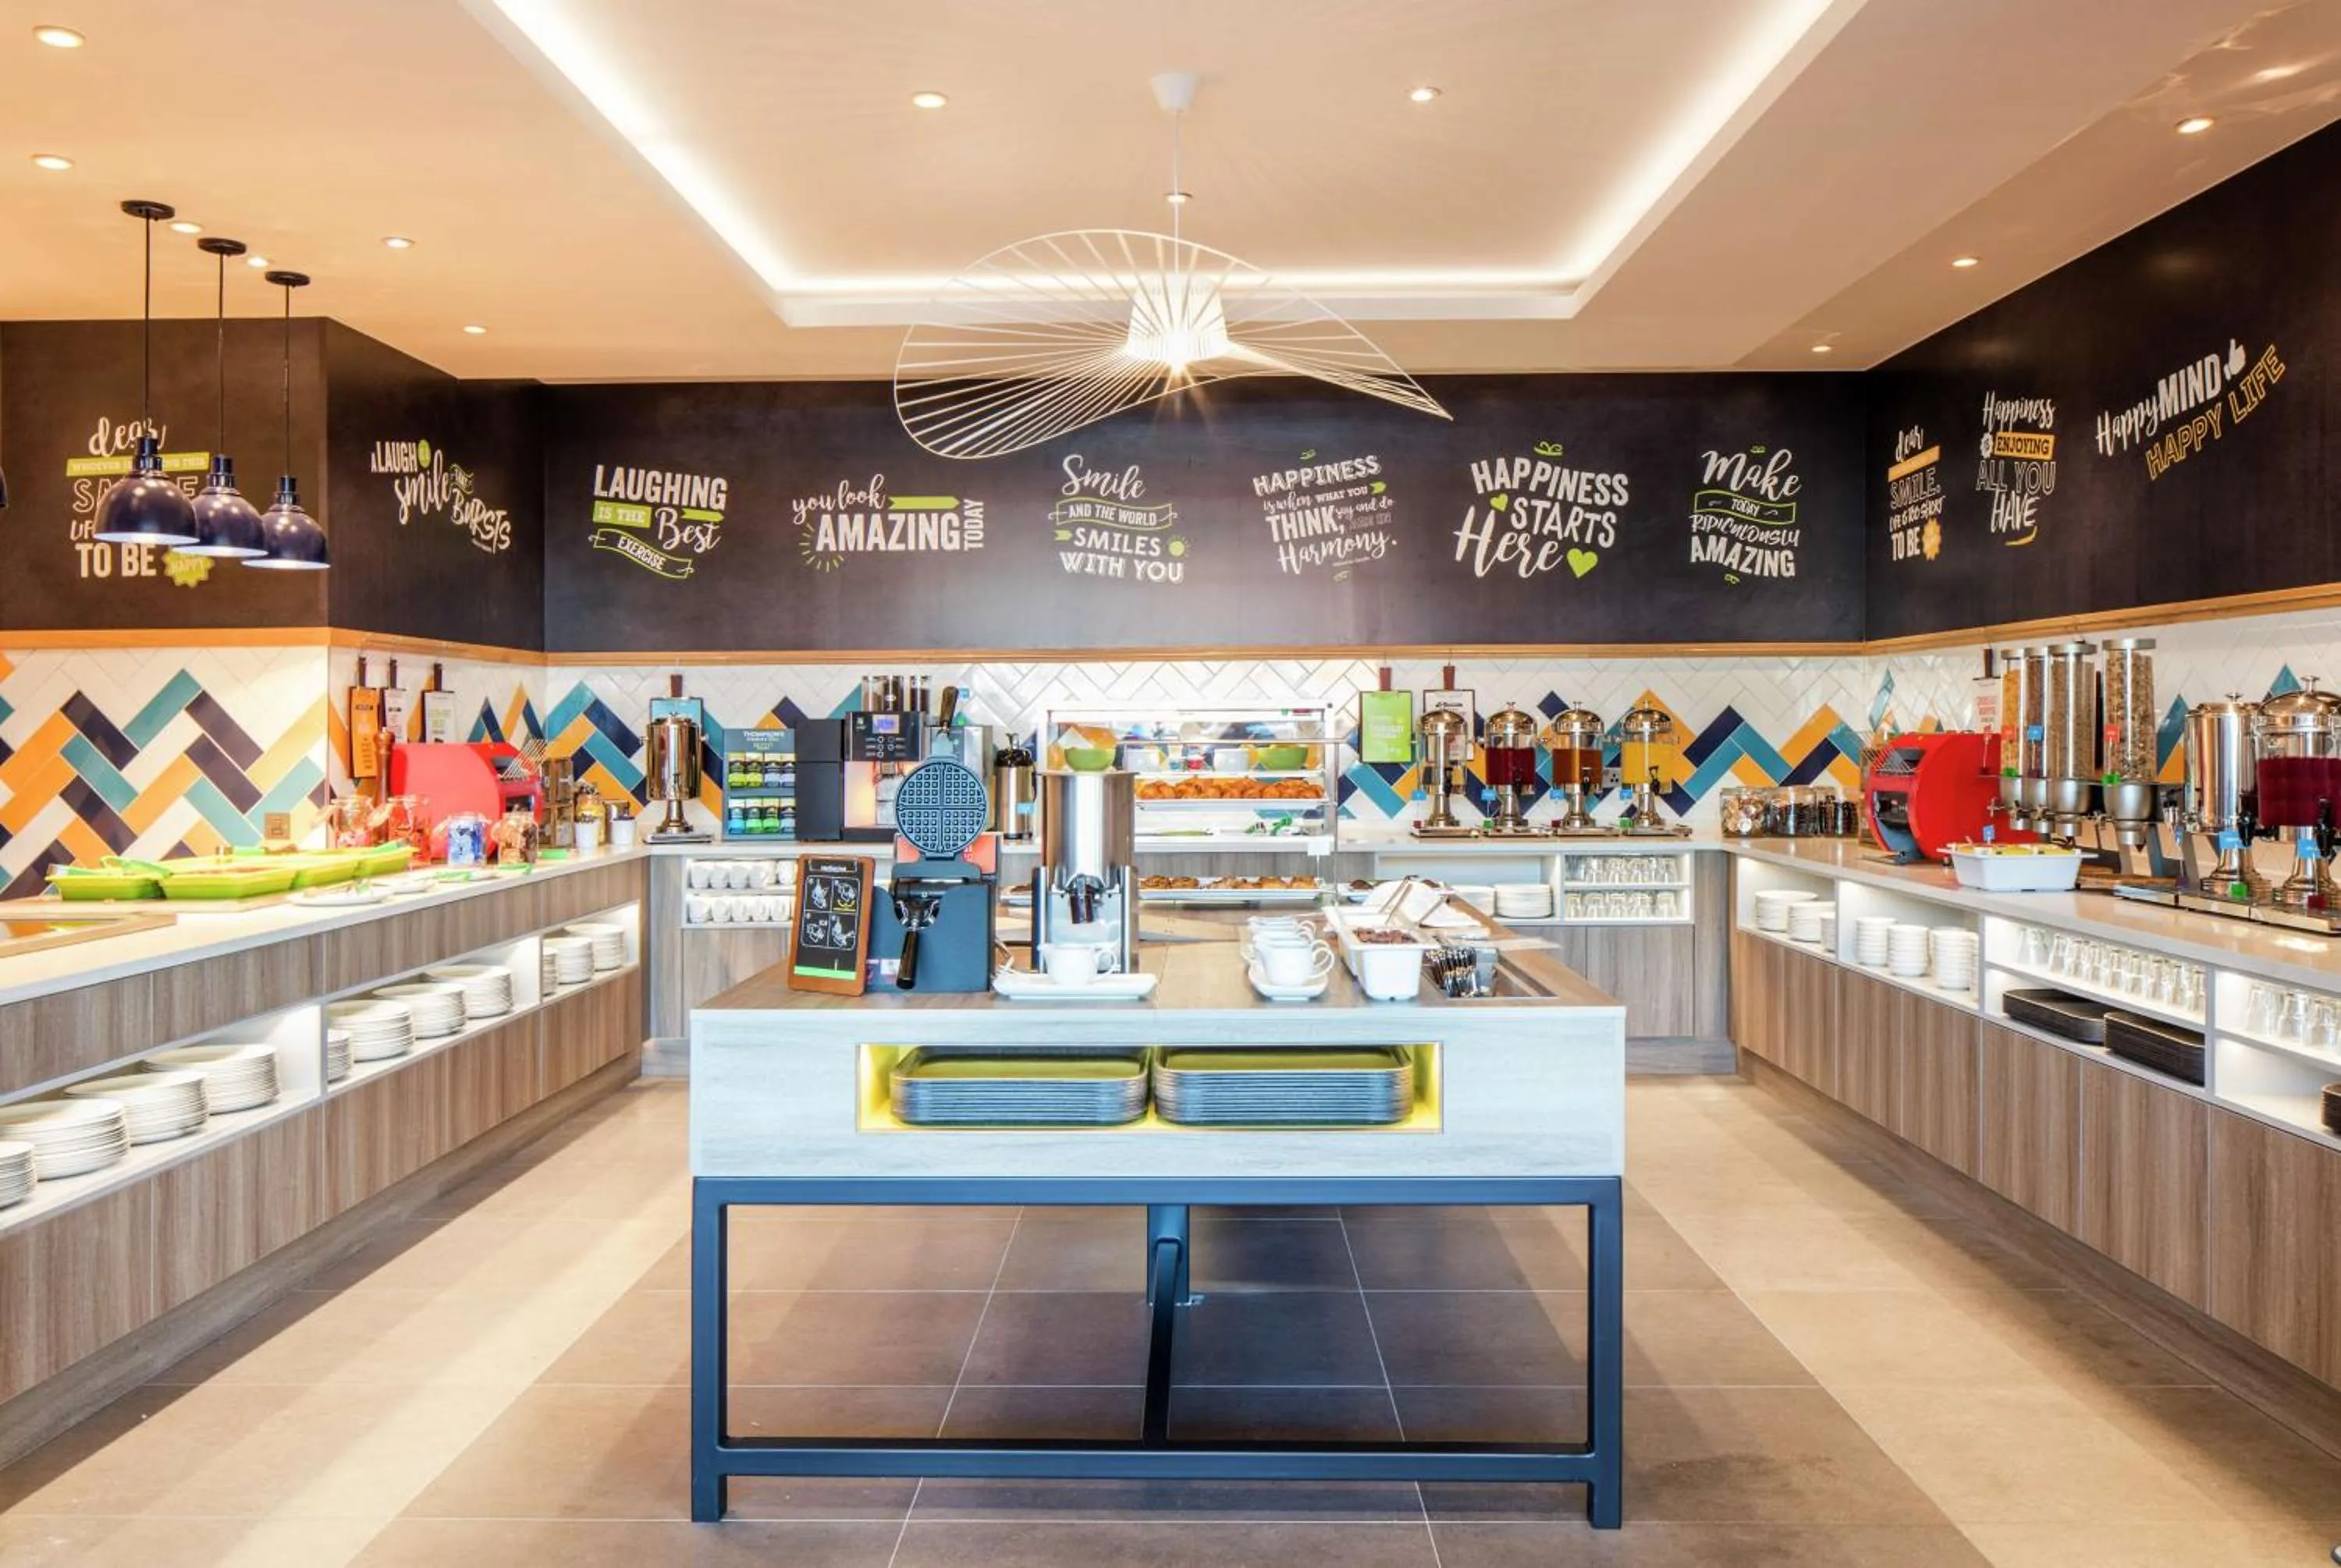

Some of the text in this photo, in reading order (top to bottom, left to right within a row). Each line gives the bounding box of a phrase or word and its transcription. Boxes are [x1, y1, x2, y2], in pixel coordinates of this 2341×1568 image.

[2158, 353, 2222, 421] MIND
[1982, 390, 2055, 431] Happiness
[2145, 343, 2286, 481] HAPPY LIFE
[376, 441, 417, 472] LAUGH
[1997, 436, 2050, 455] ENJOYING
[593, 464, 728, 511] LAUGHING
[1061, 454, 1147, 500] Smile
[1252, 455, 1382, 497] HAPPINESS
[1315, 491, 1345, 503] WHAT
[1347, 486, 1368, 497] YOU
[1471, 457, 1629, 506] HAPPINESS
[1701, 449, 1802, 502] Make
[1975, 459, 2008, 492] ALL
[2014, 461, 2056, 495] YOU
[792, 474, 886, 525] you look
[1069, 503, 1156, 526] AND THE WORLD
[1991, 488, 2041, 533] HAVE
[599, 506, 722, 553] IS THE Best
[815, 513, 961, 552] AMAZING
[964, 498, 984, 552] TODAY
[1074, 527, 1161, 556] SMILES
[1452, 505, 1564, 578] Here
[1511, 497, 1617, 548] STARTS
[1891, 531, 1904, 561] TO
[1906, 526, 1920, 558] BE
[75, 543, 157, 578] TO BE
[617, 536, 666, 570] EXERCISE
[1059, 552, 1185, 584] WITH YOU
[1690, 534, 1796, 577] AMAZING
